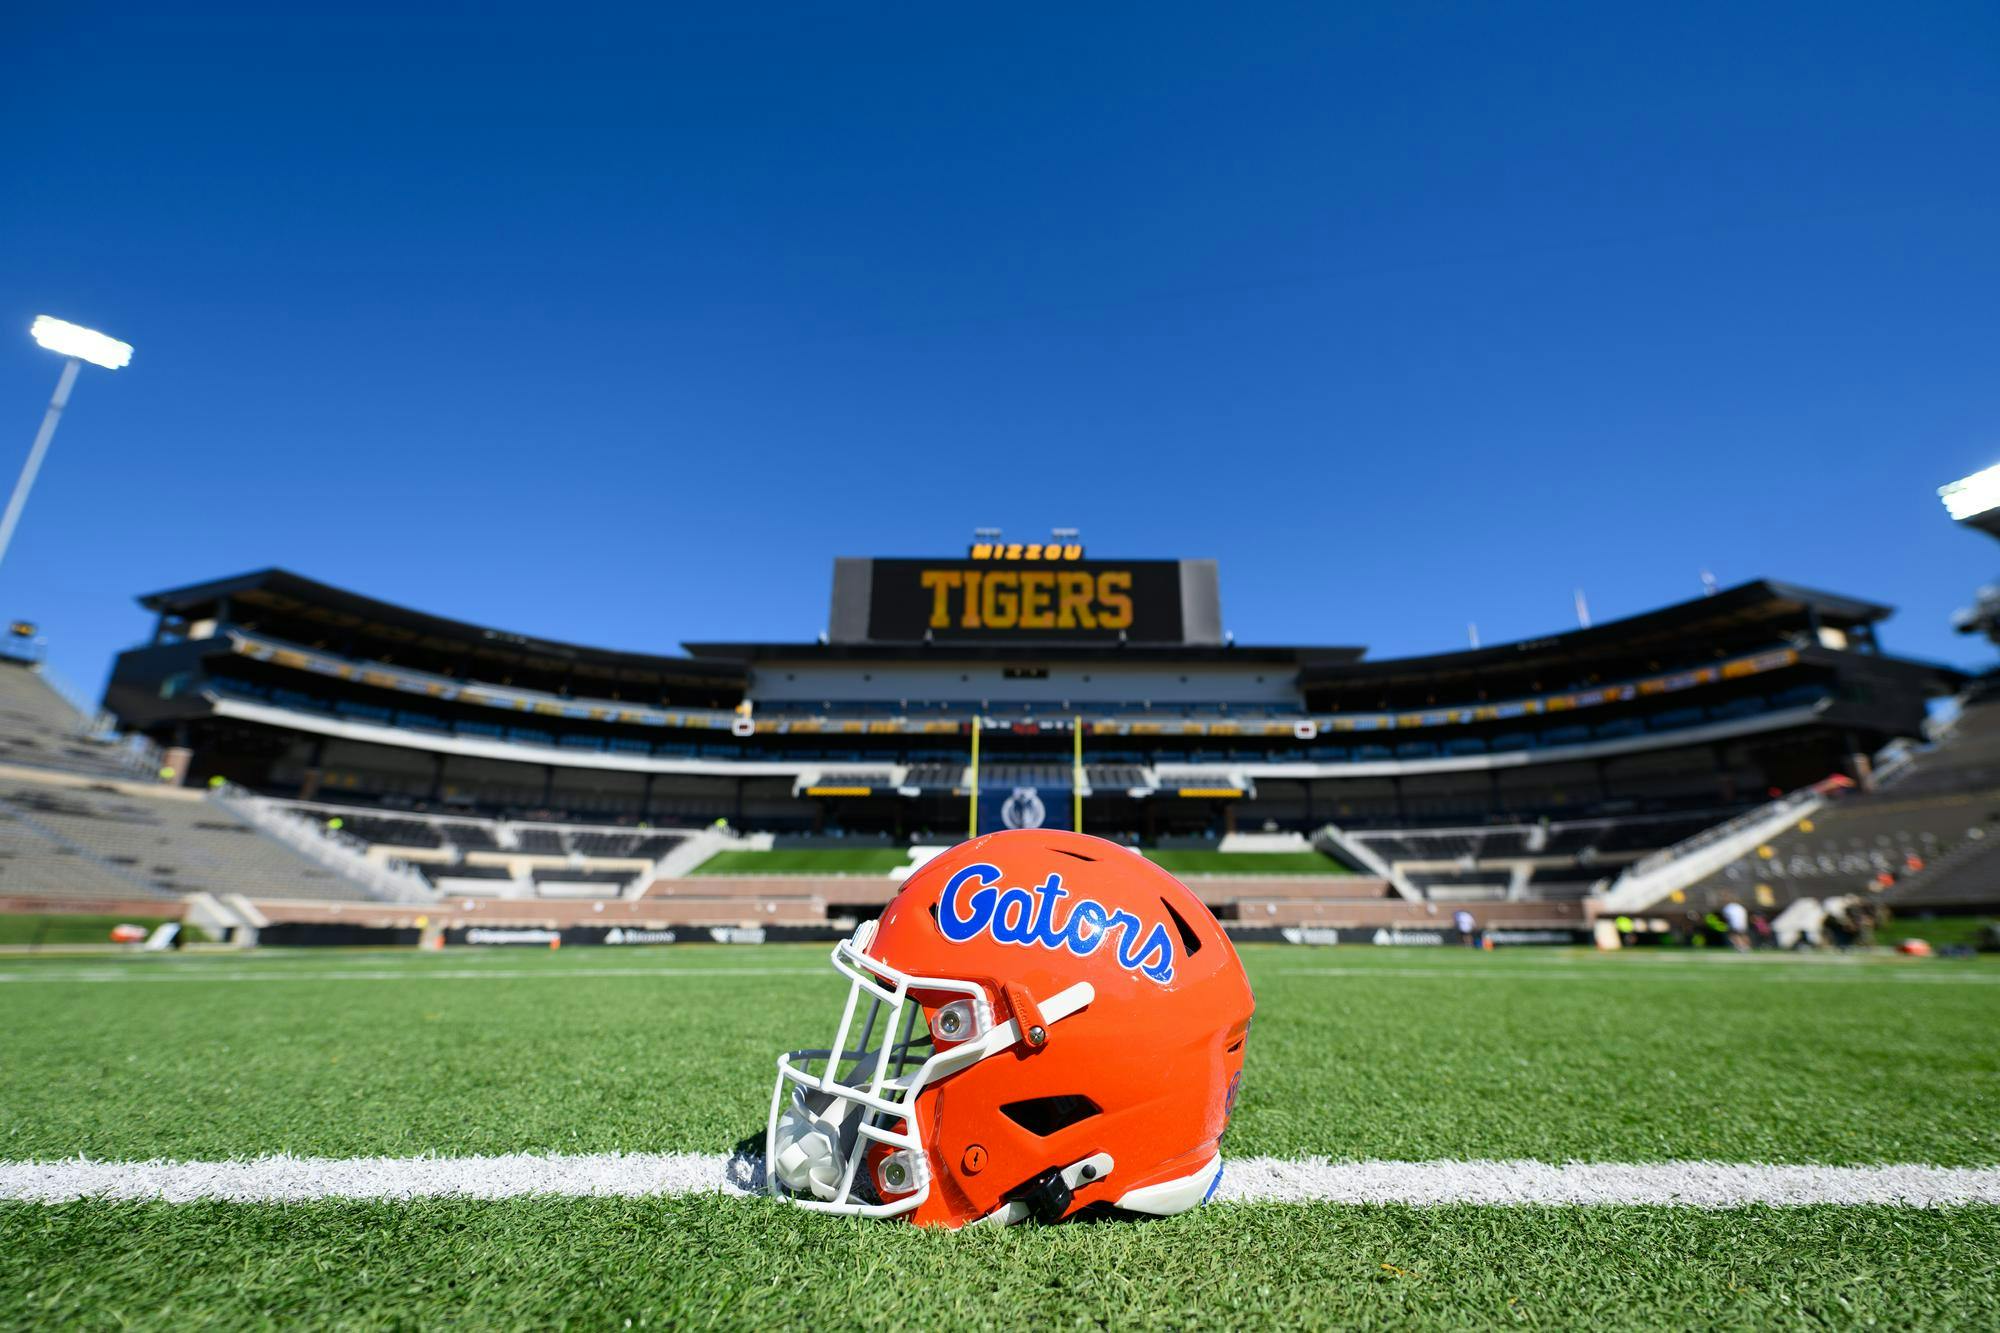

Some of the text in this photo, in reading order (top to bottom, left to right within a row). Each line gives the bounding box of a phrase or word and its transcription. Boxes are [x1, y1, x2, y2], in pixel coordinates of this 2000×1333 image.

[971, 543, 1082, 560] MIZZOU
[921, 570, 1133, 629] TIGERS
[938, 862, 1175, 985] Gators
